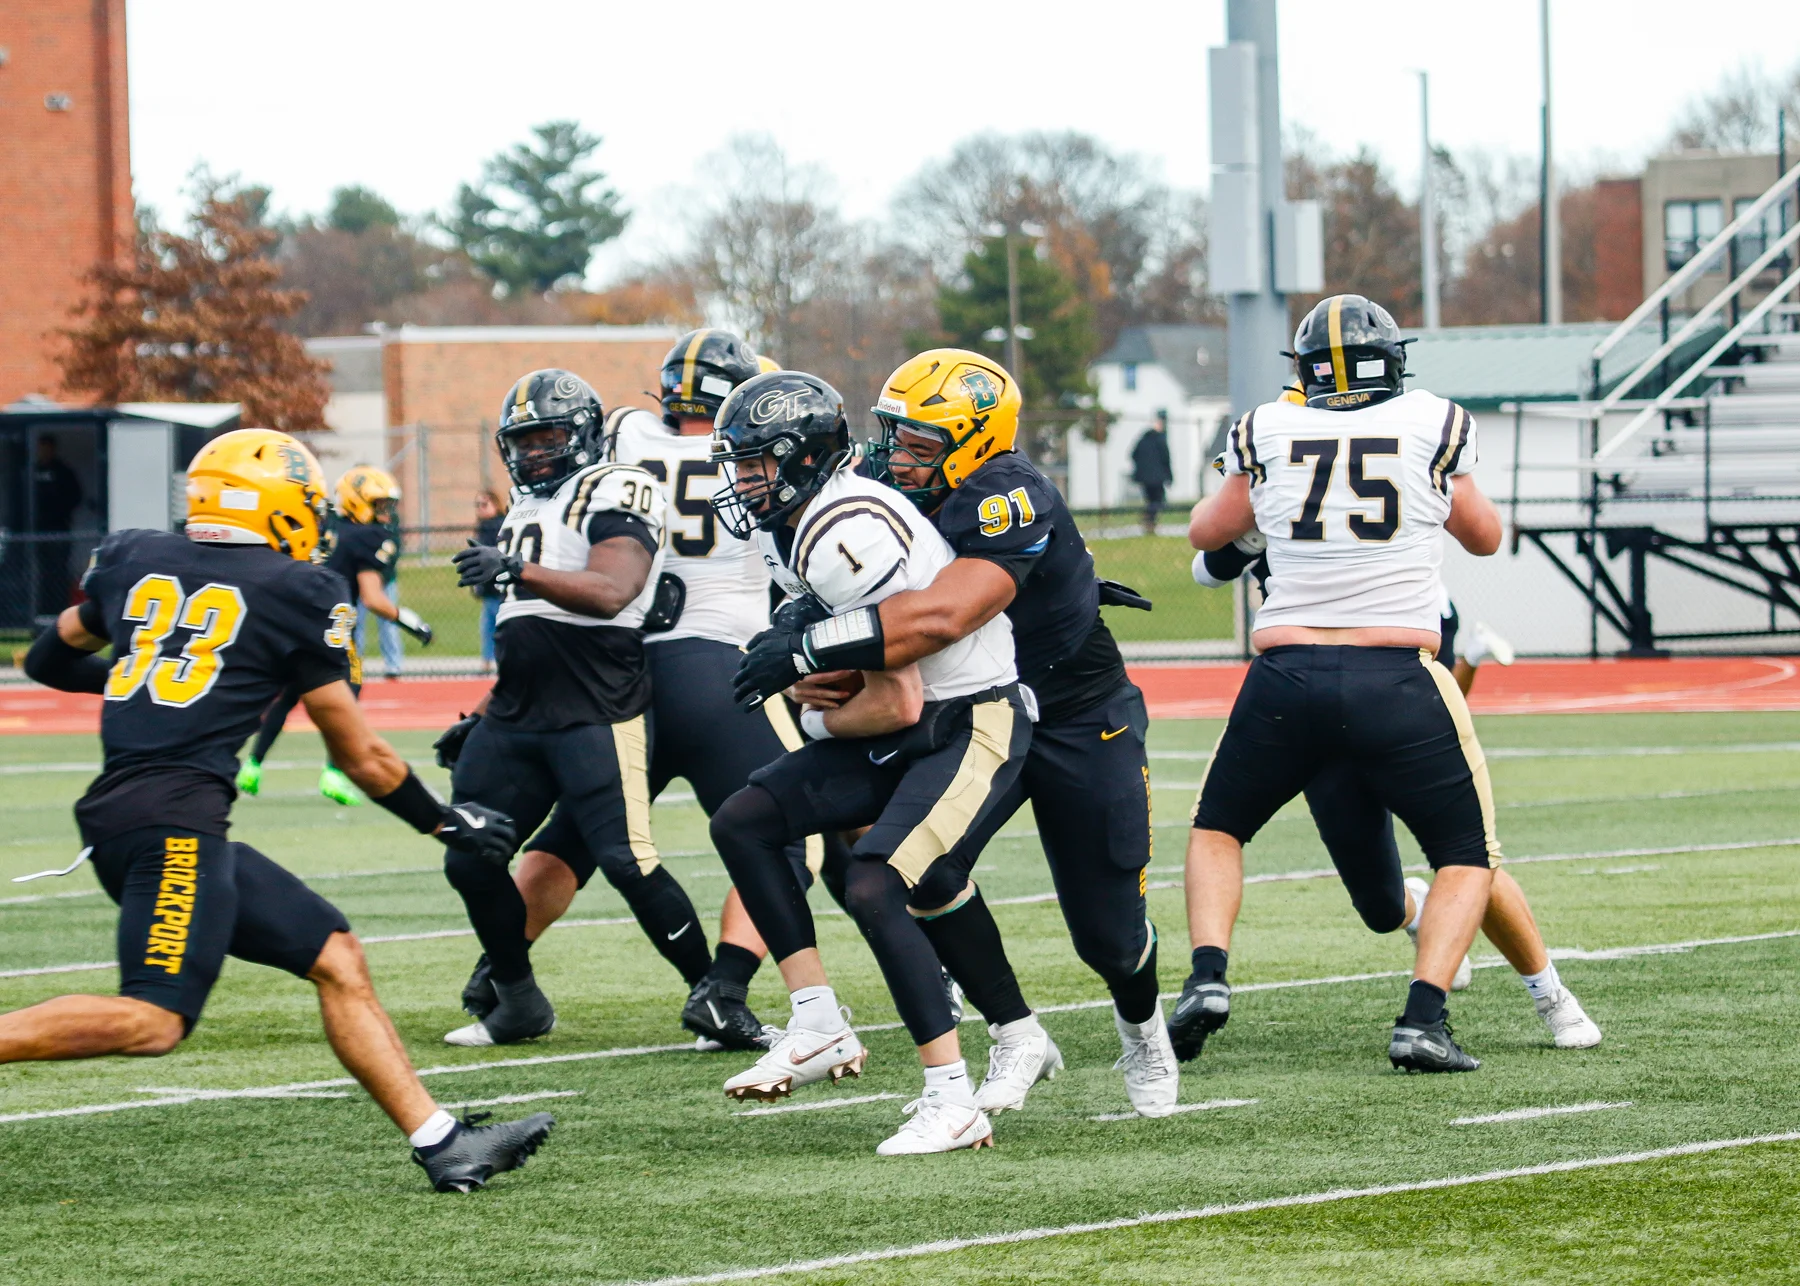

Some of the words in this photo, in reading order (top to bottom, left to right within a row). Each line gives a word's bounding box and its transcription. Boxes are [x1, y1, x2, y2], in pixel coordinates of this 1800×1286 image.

[669, 402, 708, 414] GENEVA
[750, 388, 812, 425] GT
[1326, 393, 1371, 407] GENEVA
[620, 479, 652, 516] 30
[1288, 437, 1401, 543] 75
[977, 487, 1035, 537] 91
[835, 540, 864, 577] 1
[104, 573, 248, 709] 33
[144, 836, 198, 975] BROCKPORT
